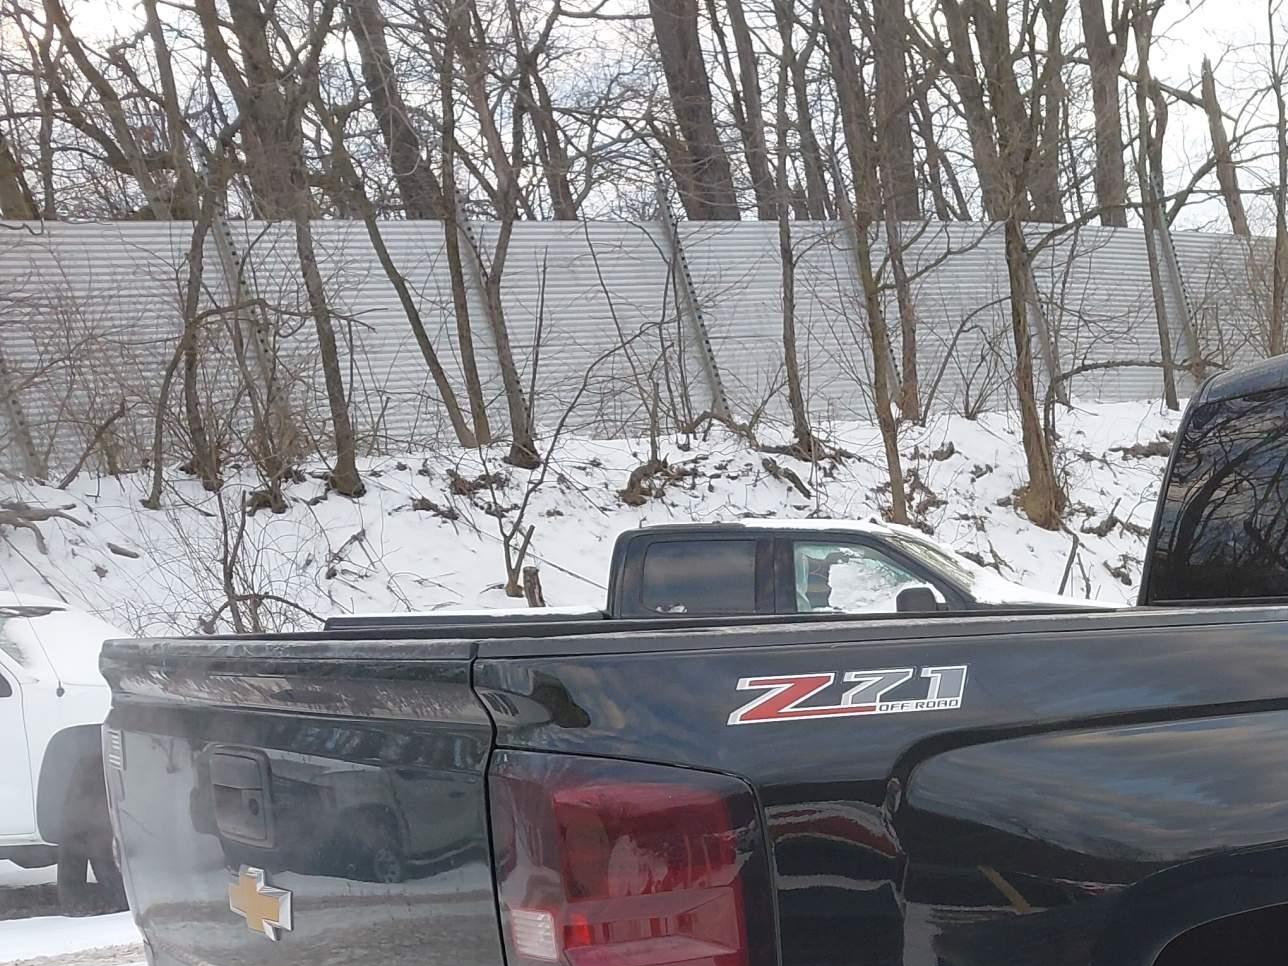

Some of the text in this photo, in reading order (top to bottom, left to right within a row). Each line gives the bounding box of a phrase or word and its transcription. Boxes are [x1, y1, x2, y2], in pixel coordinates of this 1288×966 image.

[726, 665, 968, 726] Z71
[878, 698, 960, 713] OFF ROAD
